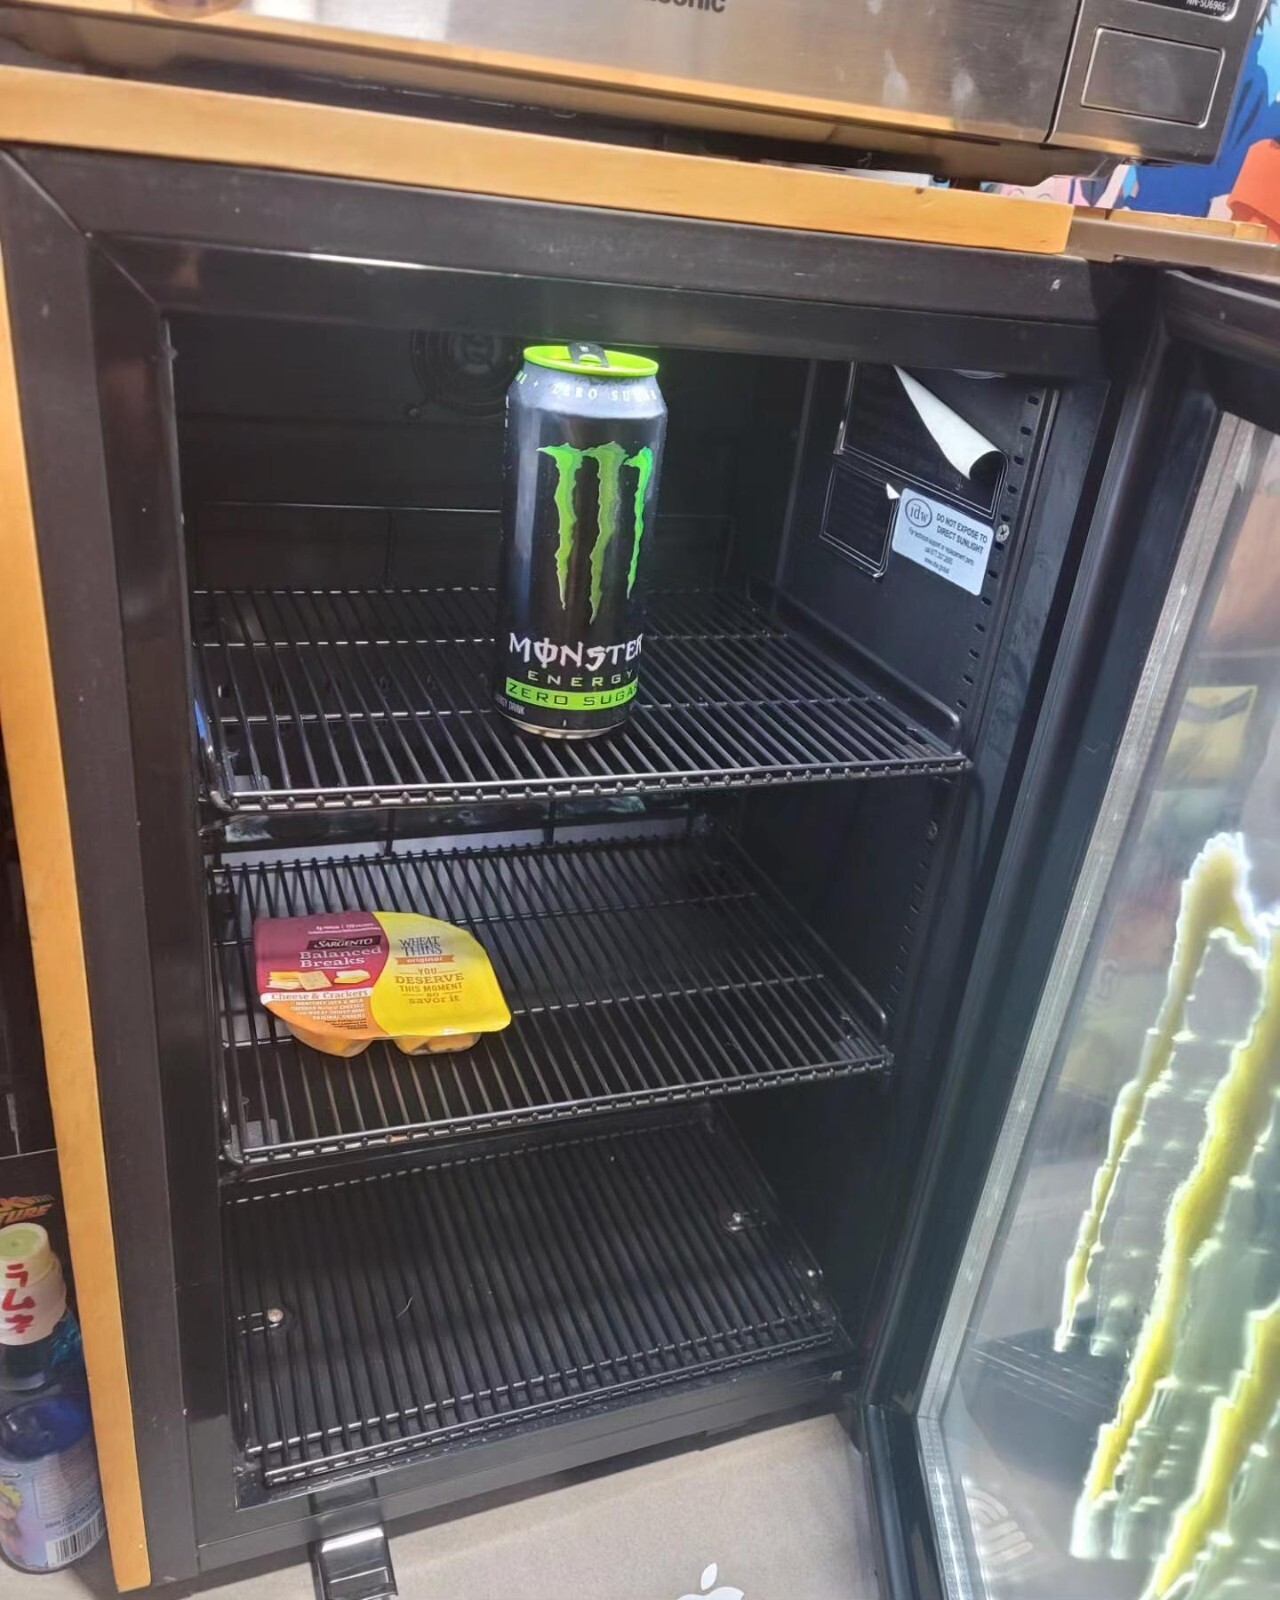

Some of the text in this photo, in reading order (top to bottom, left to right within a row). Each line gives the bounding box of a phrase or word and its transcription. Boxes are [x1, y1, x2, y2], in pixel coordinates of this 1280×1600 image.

[936, 513, 988, 543] DO NOT EXPOSE TO
[936, 525, 984, 555] DIRECT SUNLIGHT
[509, 632, 644, 672] MONSTER
[527, 670, 633, 688] ENERGY
[508, 682, 568, 706] ZERO
[313, 938, 374, 950] SARGENTO
[398, 935, 441, 947] WHEAT
[299, 945, 383, 961] Balanced
[400, 944, 443, 957] THINS
[299, 957, 366, 969] Breaks
[417, 967, 438, 975] YOU
[395, 972, 464, 985] DESERVE
[399, 981, 463, 993] THIS MOMENT
[271, 989, 369, 1001] Cheese & Crackers
[408, 997, 447, 1005] savor
[2, 1263, 36, 1334] ラムネ
